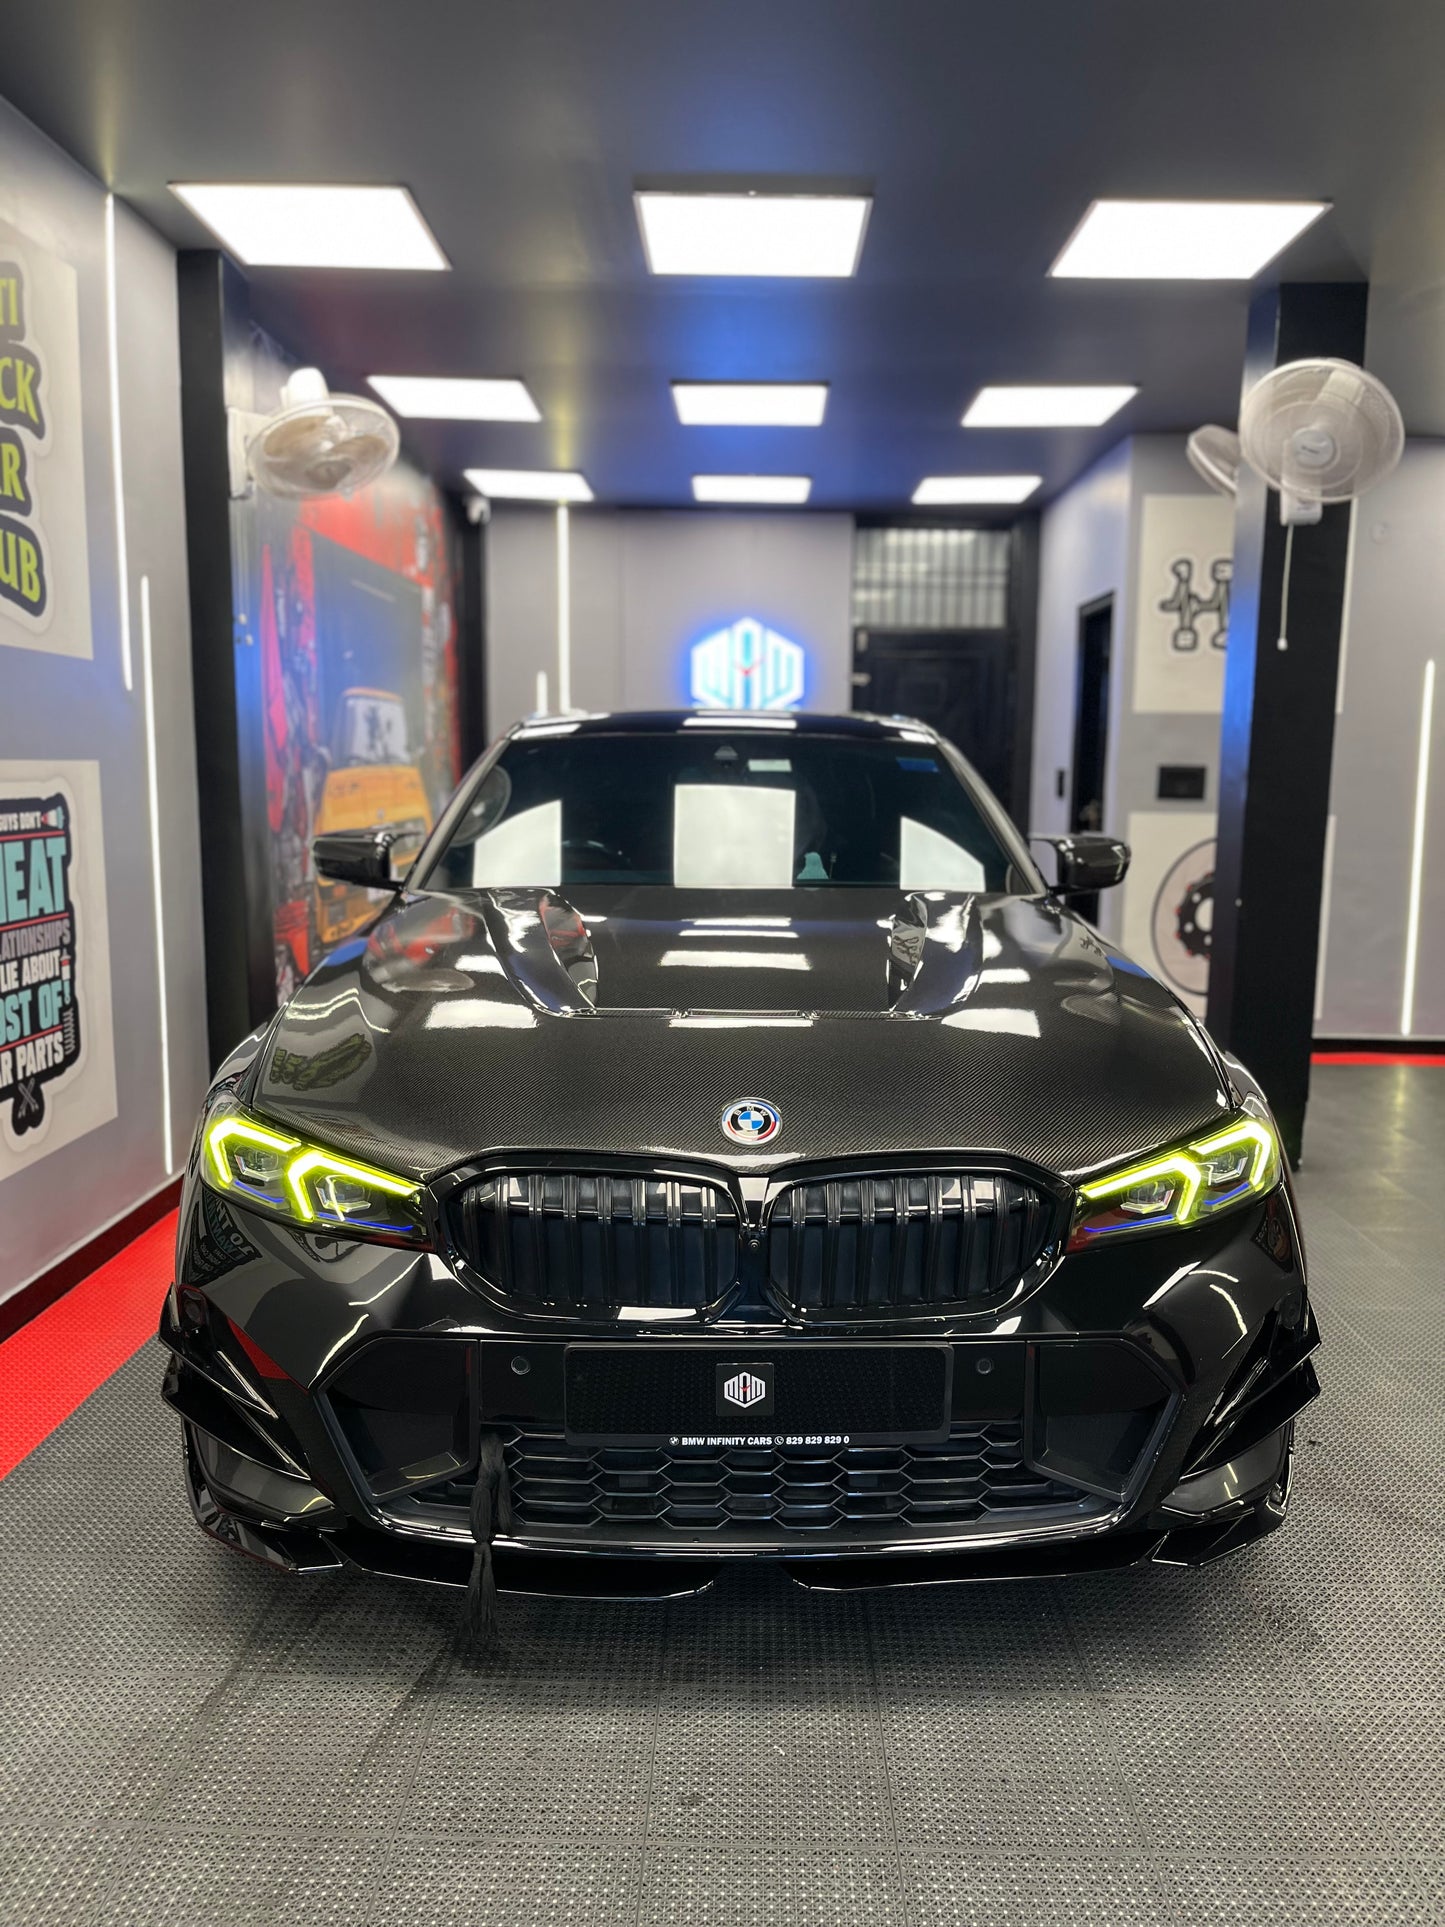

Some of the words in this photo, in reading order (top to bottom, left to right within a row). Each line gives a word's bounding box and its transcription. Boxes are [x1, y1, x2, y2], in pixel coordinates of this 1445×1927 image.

[0, 918, 71, 962] ATIONSHIPS
[22, 949, 60, 986] ABOUT
[38, 980, 62, 1030] OF
[16, 1030, 64, 1081] PARTS
[681, 1437, 705, 1446] BMW
[707, 1436, 746, 1446] INFINITY
[747, 1436, 773, 1446] CARS
[786, 1436, 803, 1445] 829
[805, 1435, 823, 1445] 829
[824, 1435, 842, 1445] 829
[843, 1435, 850, 1444] 0
